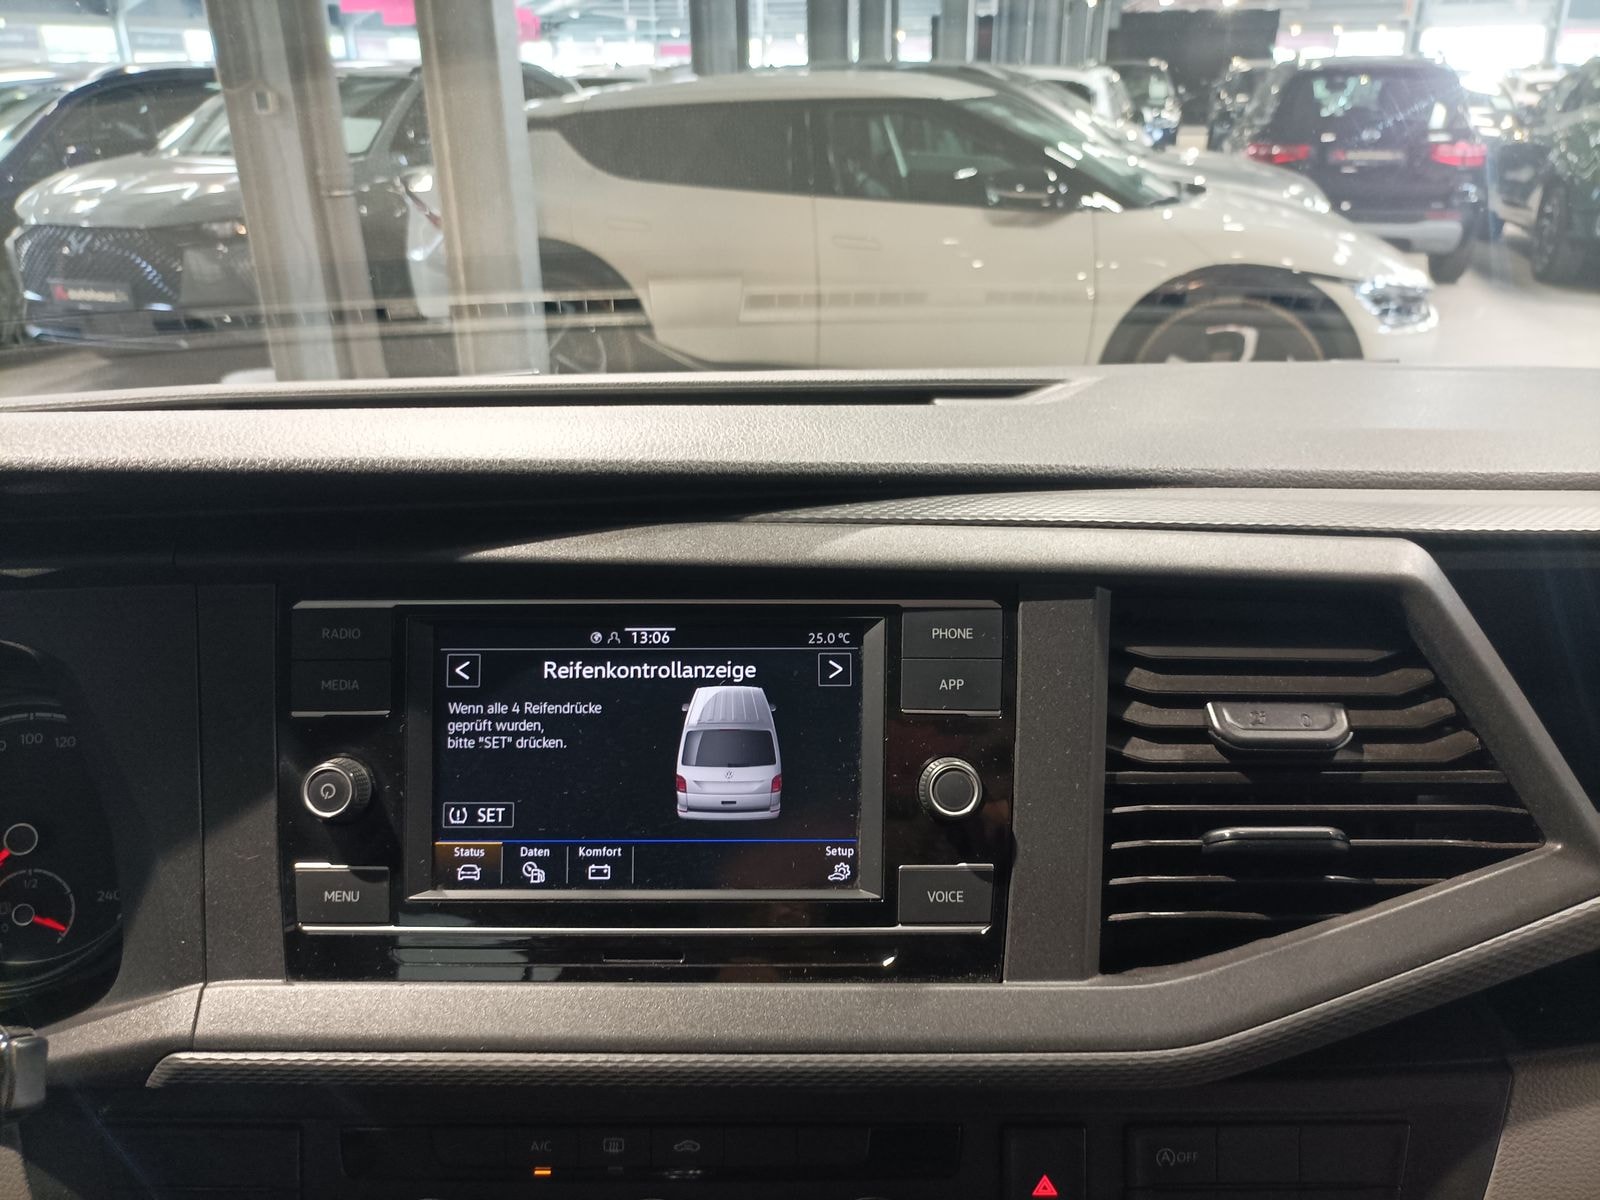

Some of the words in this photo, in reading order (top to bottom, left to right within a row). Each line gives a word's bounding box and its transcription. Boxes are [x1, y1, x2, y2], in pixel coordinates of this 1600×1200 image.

[321, 627, 361, 640] RADIO
[631, 631, 670, 645] 13:06
[931, 627, 974, 639] PHONE
[543, 660, 757, 682] Reifenkontrollanzeige
[321, 679, 360, 691] MEDIA
[939, 678, 965, 691] APP
[448, 702, 484, 715] Wenn
[487, 702, 509, 715] alle
[511, 702, 521, 715] 4
[524, 702, 602, 715] Reifendrücke
[447, 719, 493, 734] geprüft
[495, 719, 545, 734] wurden,
[20, 732, 44, 745] 100
[55, 735, 77, 749] 120
[447, 736, 476, 750] bitte
[515, 736, 568, 749] drücken.
[477, 807, 506, 823] SET
[454, 846, 485, 858] Status
[520, 846, 550, 858] Daten
[578, 846, 622, 858] Komfort
[825, 845, 855, 858] Setup
[324, 890, 360, 903] MENU
[927, 890, 964, 903] VOICE
[531, 1140, 552, 1152] A/C
